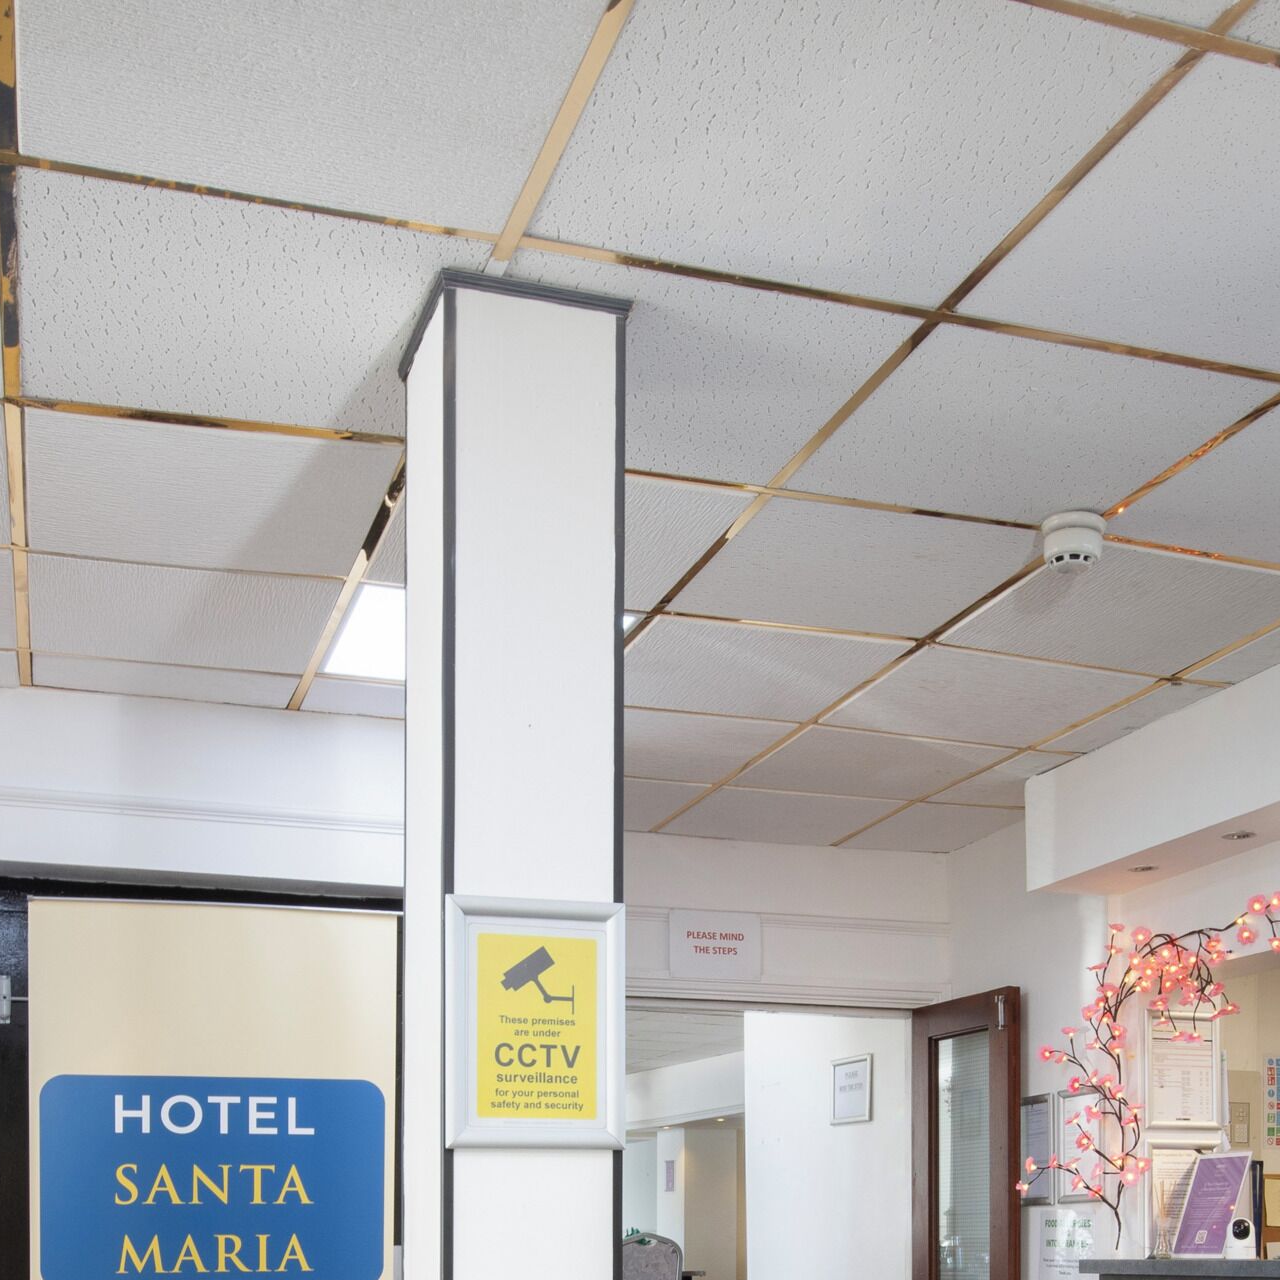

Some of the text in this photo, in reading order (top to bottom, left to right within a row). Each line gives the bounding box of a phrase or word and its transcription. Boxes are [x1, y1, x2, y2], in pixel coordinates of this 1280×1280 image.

[686, 930, 745, 942] PLEASE MIND
[693, 945, 738, 956] THE STEPS
[498, 1015, 576, 1028] These premises
[514, 1028, 561, 1038] are under
[494, 1042, 581, 1068] CCTV
[496, 1072, 578, 1084] surveillance
[495, 1087, 580, 1101] for your personal
[490, 1100, 584, 1112] safety and security
[114, 1094, 316, 1135] HOTEL
[114, 1163, 315, 1205] SANTA
[115, 1233, 315, 1274] MARIA
